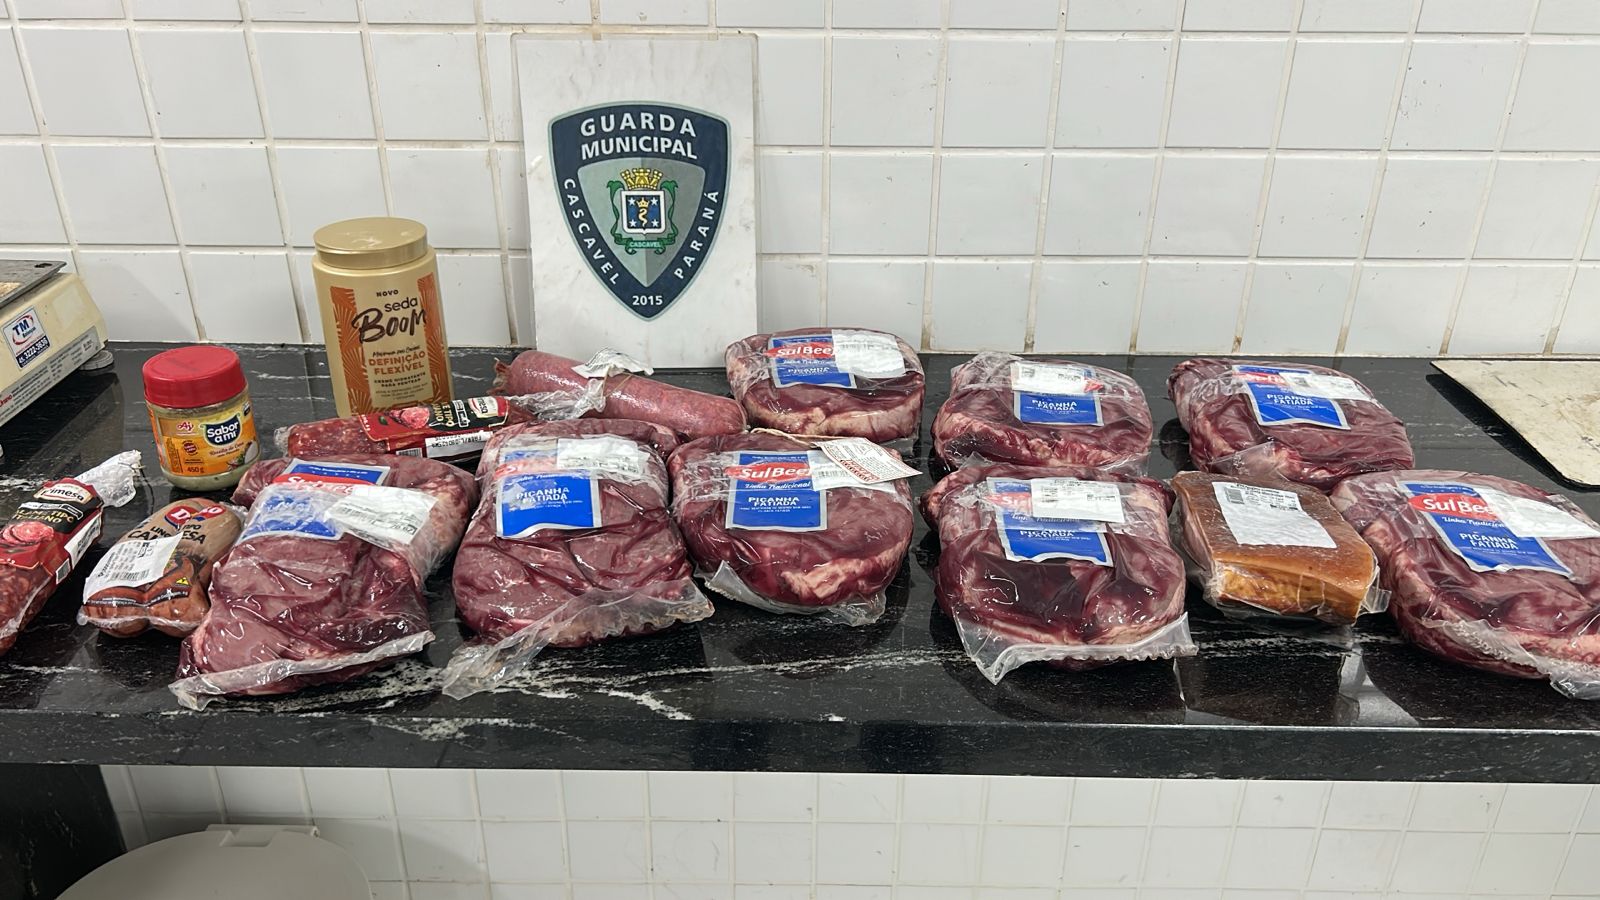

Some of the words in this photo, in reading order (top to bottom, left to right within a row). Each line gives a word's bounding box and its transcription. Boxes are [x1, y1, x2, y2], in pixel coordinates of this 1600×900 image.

[580, 112, 697, 137] GUARDA
[581, 136, 698, 160] MUNICIPAL
[564, 178, 620, 285] CASCAVEL
[674, 191, 719, 279] PARANÁ
[376, 289, 399, 297] NOVO
[632, 295, 663, 306] 2015
[384, 297, 418, 312] seda
[12, 319, 30, 336] TM
[369, 350, 426, 367] DEFINIÇÃO
[374, 361, 425, 376] FLEXÍVEL
[516, 487, 570, 500] PICANHA
[1467, 519, 1505, 527] Tradicion
[1459, 533, 1517, 544] PICANHA
[1469, 540, 1519, 550] FATIADA
